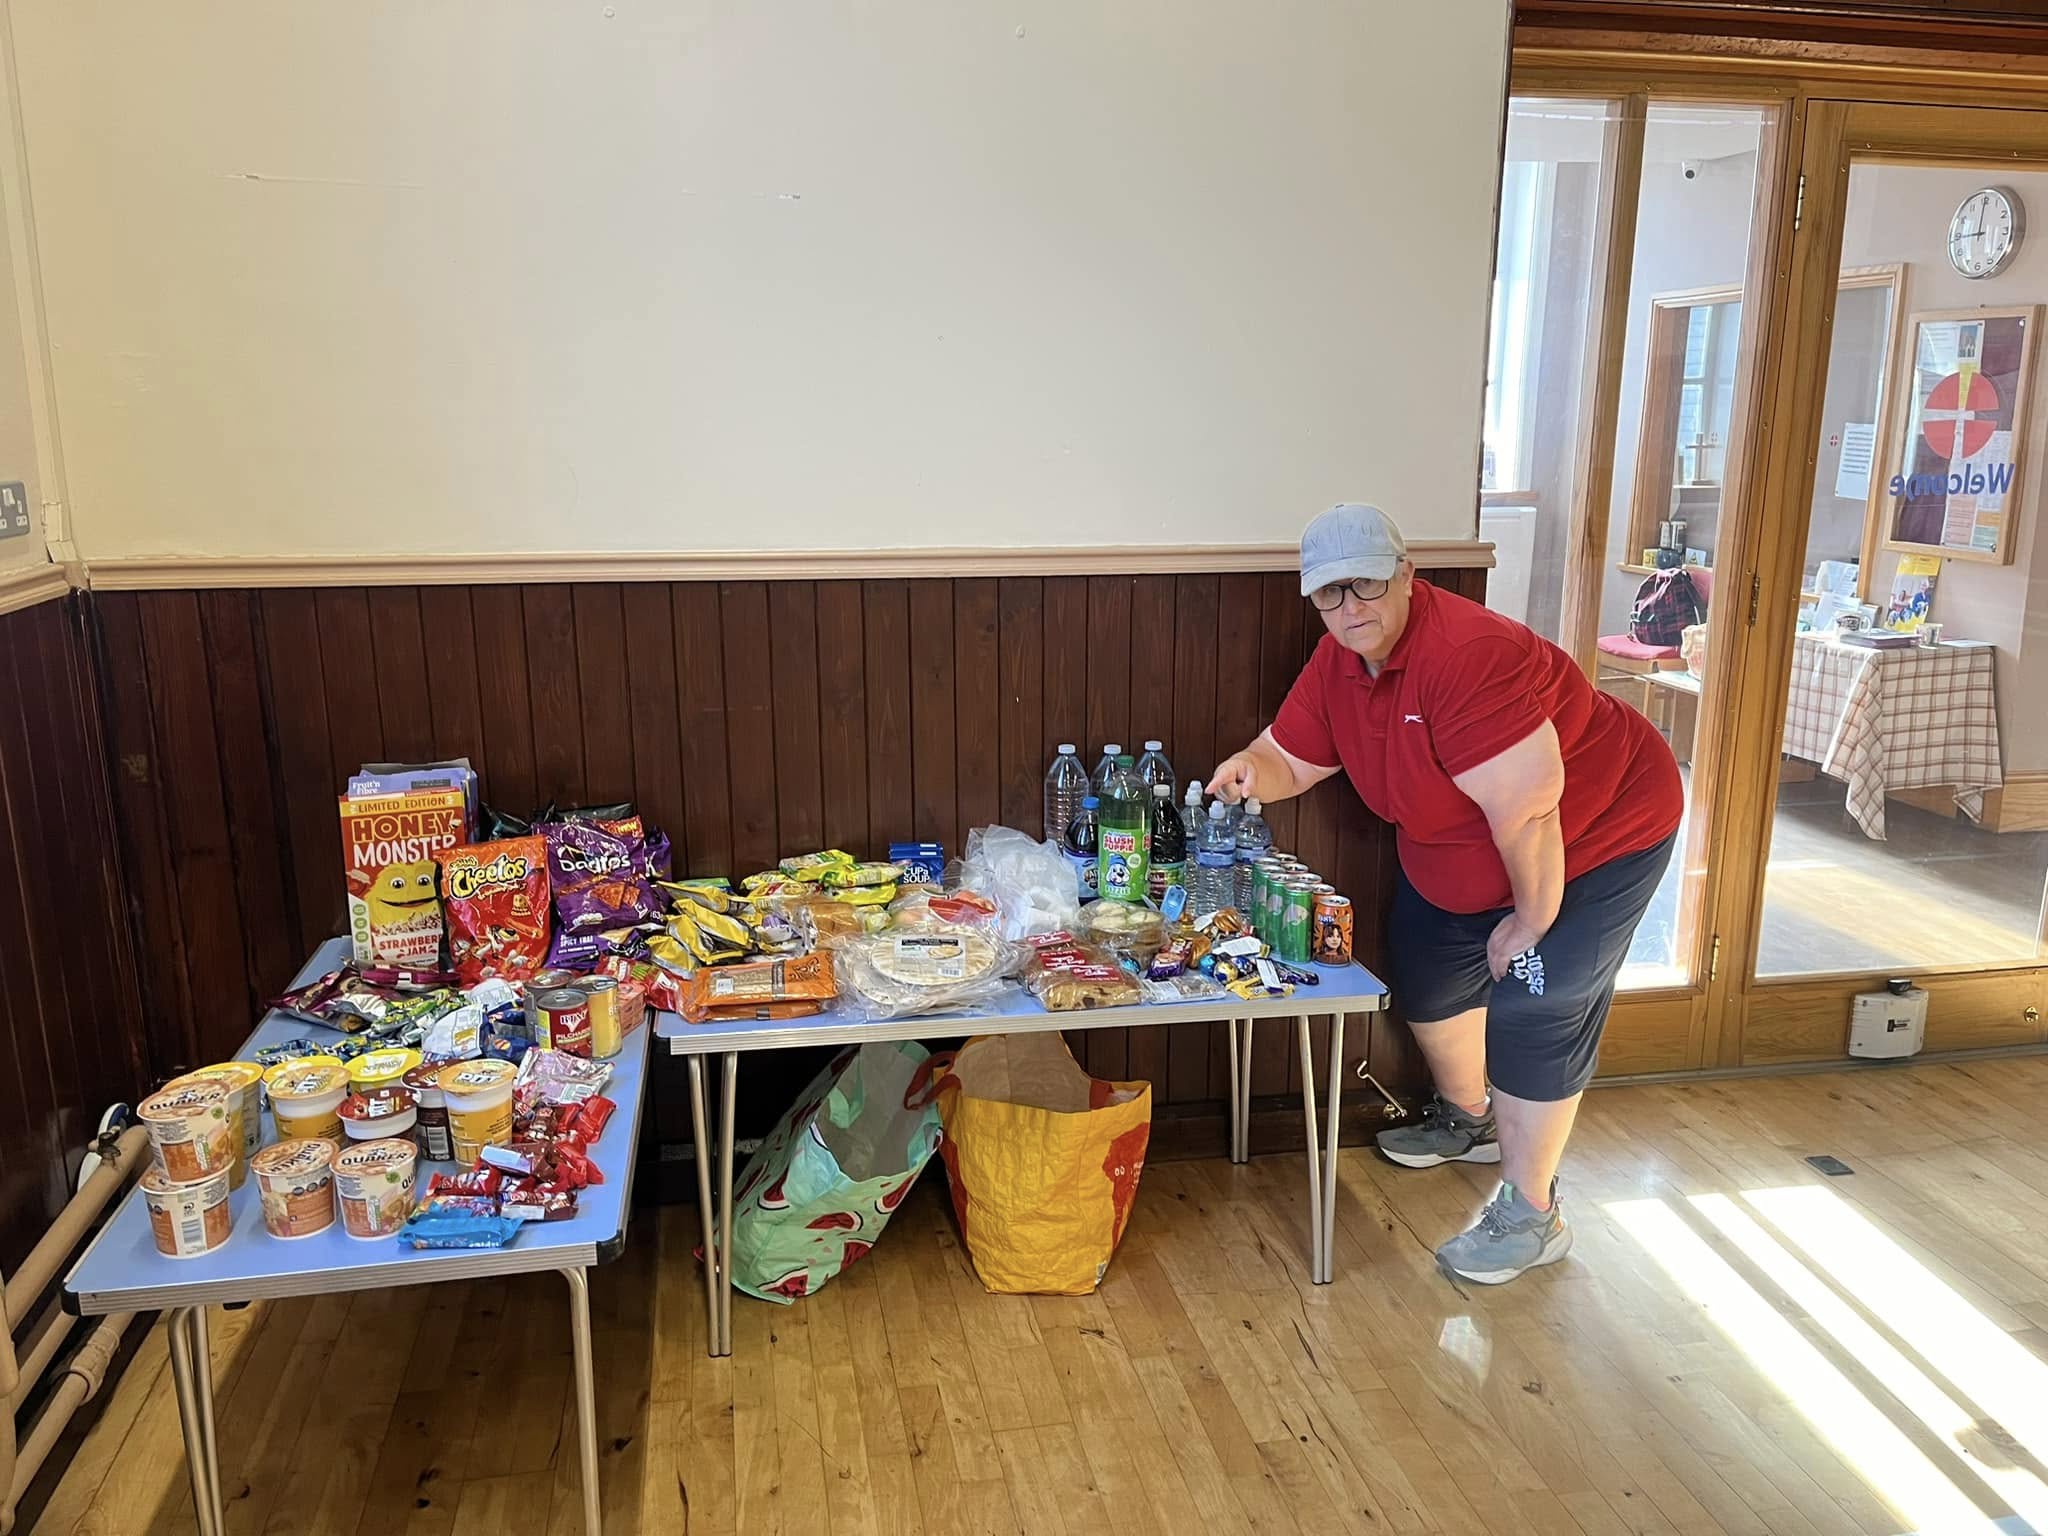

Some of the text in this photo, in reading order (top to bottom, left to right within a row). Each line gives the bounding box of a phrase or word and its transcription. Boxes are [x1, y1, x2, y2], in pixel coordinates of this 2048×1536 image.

[2000, 210, 2008, 219] 2
[358, 797, 446, 813] LIMITED EDITION
[352, 810, 455, 843] HONEY
[451, 854, 528, 899] Cheetos
[903, 874, 930, 884] SOUP
[407, 946, 427, 957] JAM
[149, 1092, 221, 1110] QUAKER
[341, 1152, 408, 1166] QUAKER
